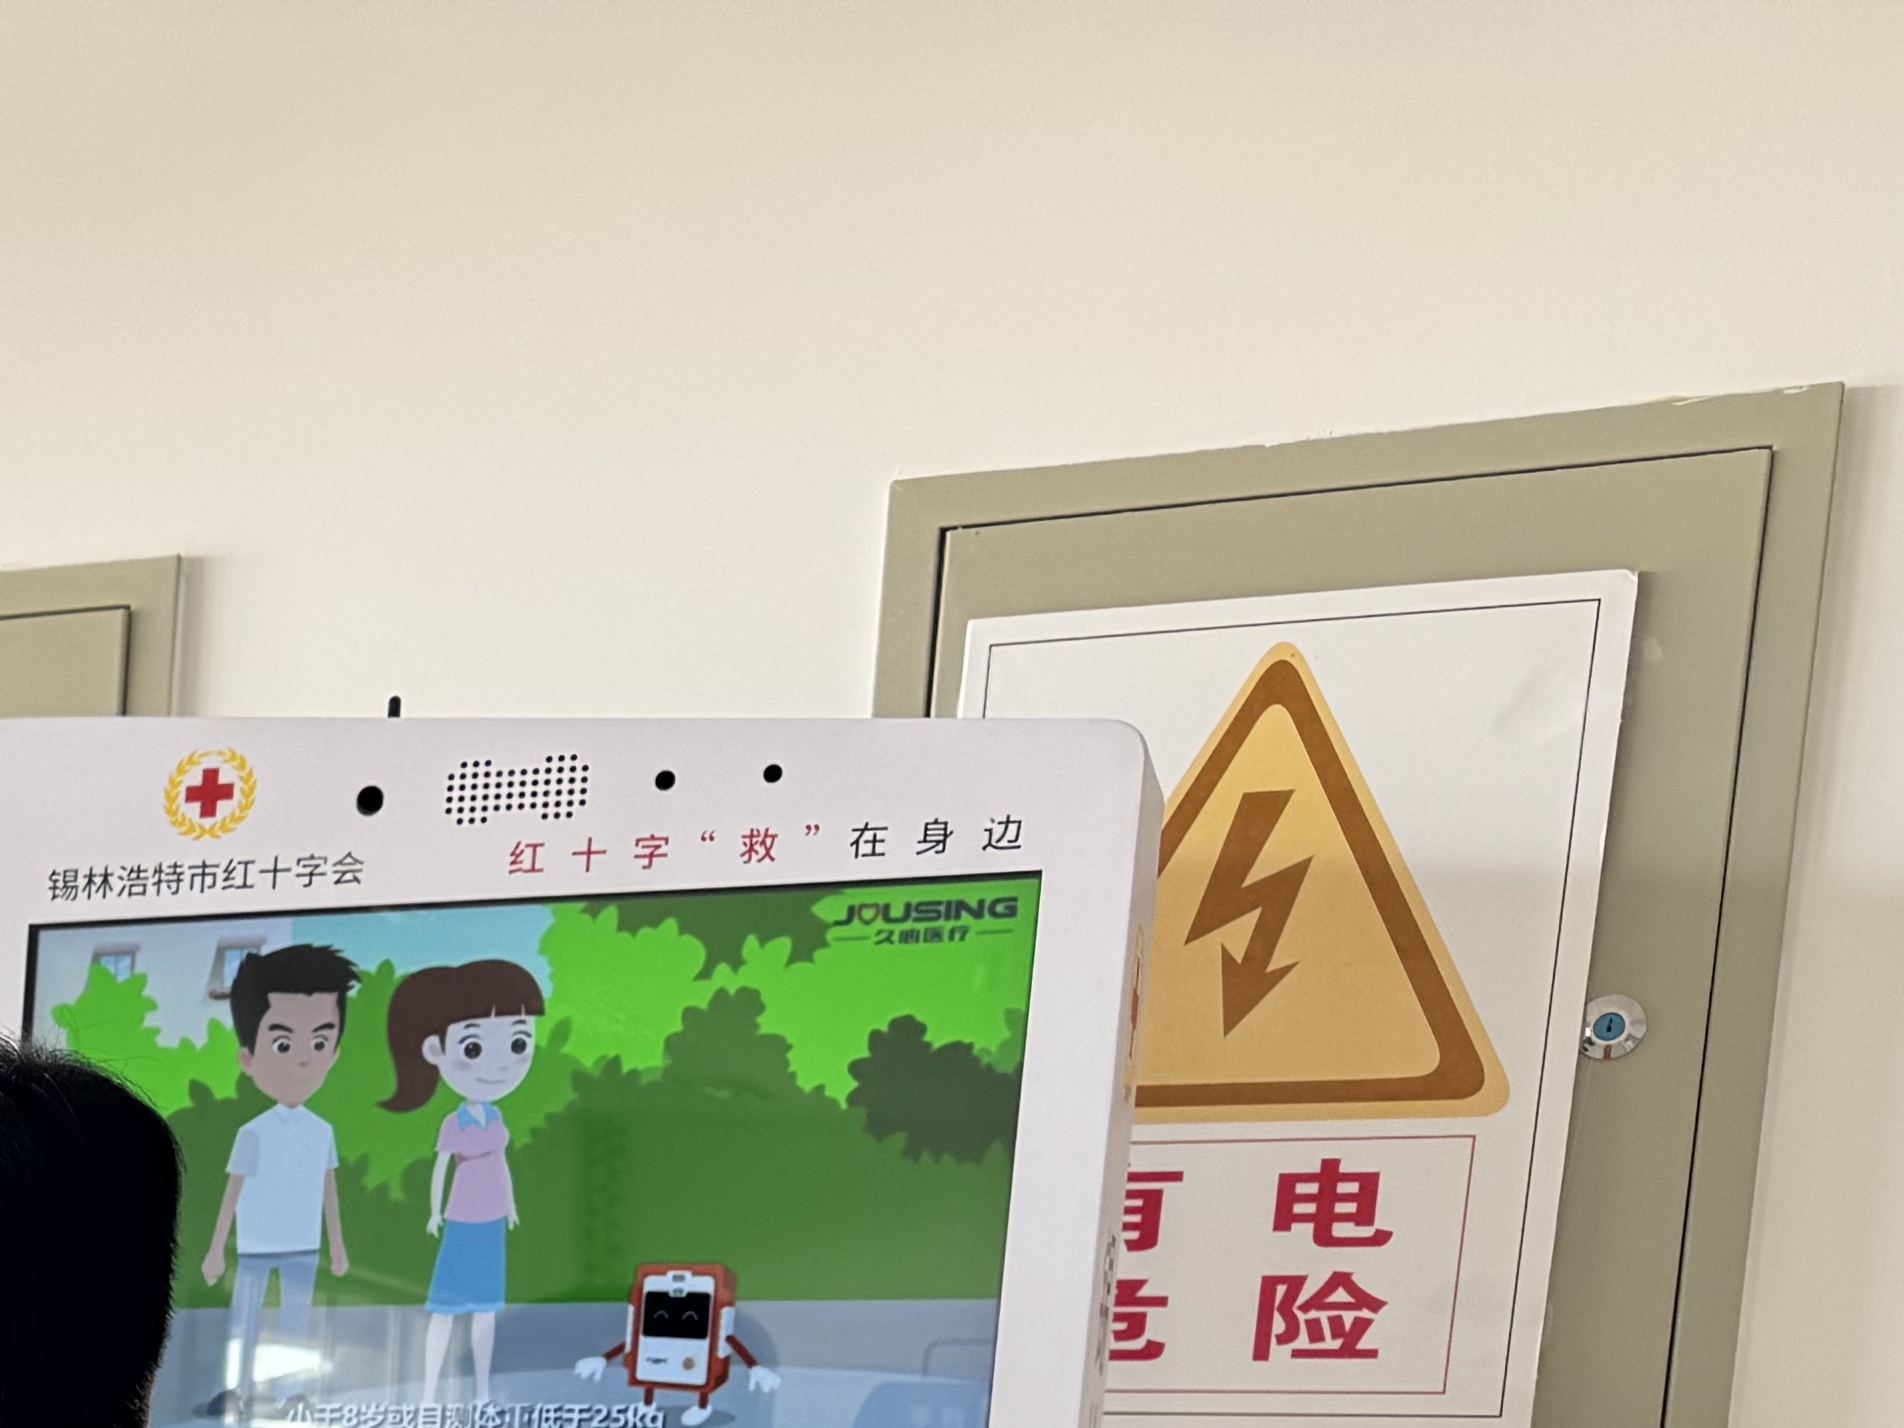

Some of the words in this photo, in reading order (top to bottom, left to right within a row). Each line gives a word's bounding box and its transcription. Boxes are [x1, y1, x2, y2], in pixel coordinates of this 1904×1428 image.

[47, 850, 366, 904] 锡林浩特市红十字会
[1118, 1158, 1394, 1250] 有电
[1103, 1270, 1389, 1362] 危险
